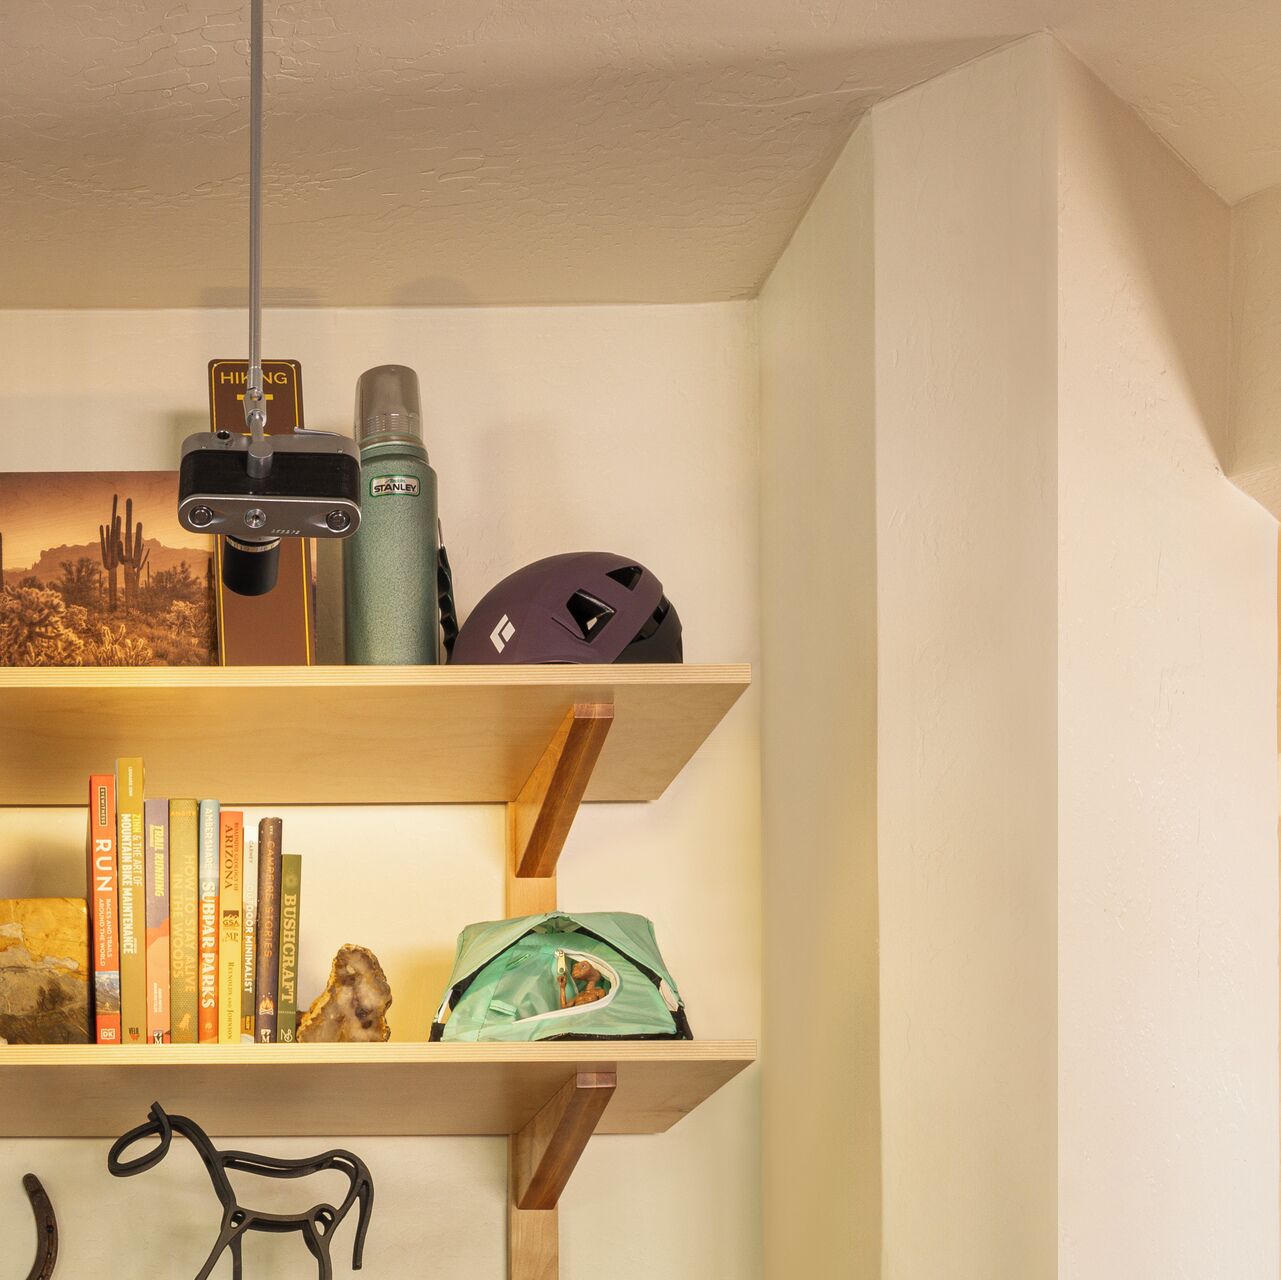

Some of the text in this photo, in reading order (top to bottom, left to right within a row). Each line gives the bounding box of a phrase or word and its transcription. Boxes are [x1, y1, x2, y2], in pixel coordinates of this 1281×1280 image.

[221, 372, 287, 384] HIKNG
[374, 484, 416, 492] STANLEY
[132, 814, 141, 833] ZINN
[133, 842, 141, 857] THE
[205, 808, 215, 869] AMBER SHARE
[96, 839, 112, 891] RUN
[121, 814, 133, 954] MOUNTAIN BIKE MAINTENANCE
[133, 860, 142, 875] ART
[133, 876, 142, 886] OF
[154, 825, 164, 896] TRAIL RUNNING
[225, 824, 233, 889] ARIZONA
[173, 874, 184, 978] IN THE WOODS
[185, 856, 196, 992] HOW TO STAY ALIVE
[264, 841, 275, 958] CAMPFIRE STORIES
[202, 882, 216, 1008] SUBPAR PARKS
[244, 886, 254, 993] OUTDOOR MINIMALIST
[282, 894, 296, 1003] BUSHCRAFT
